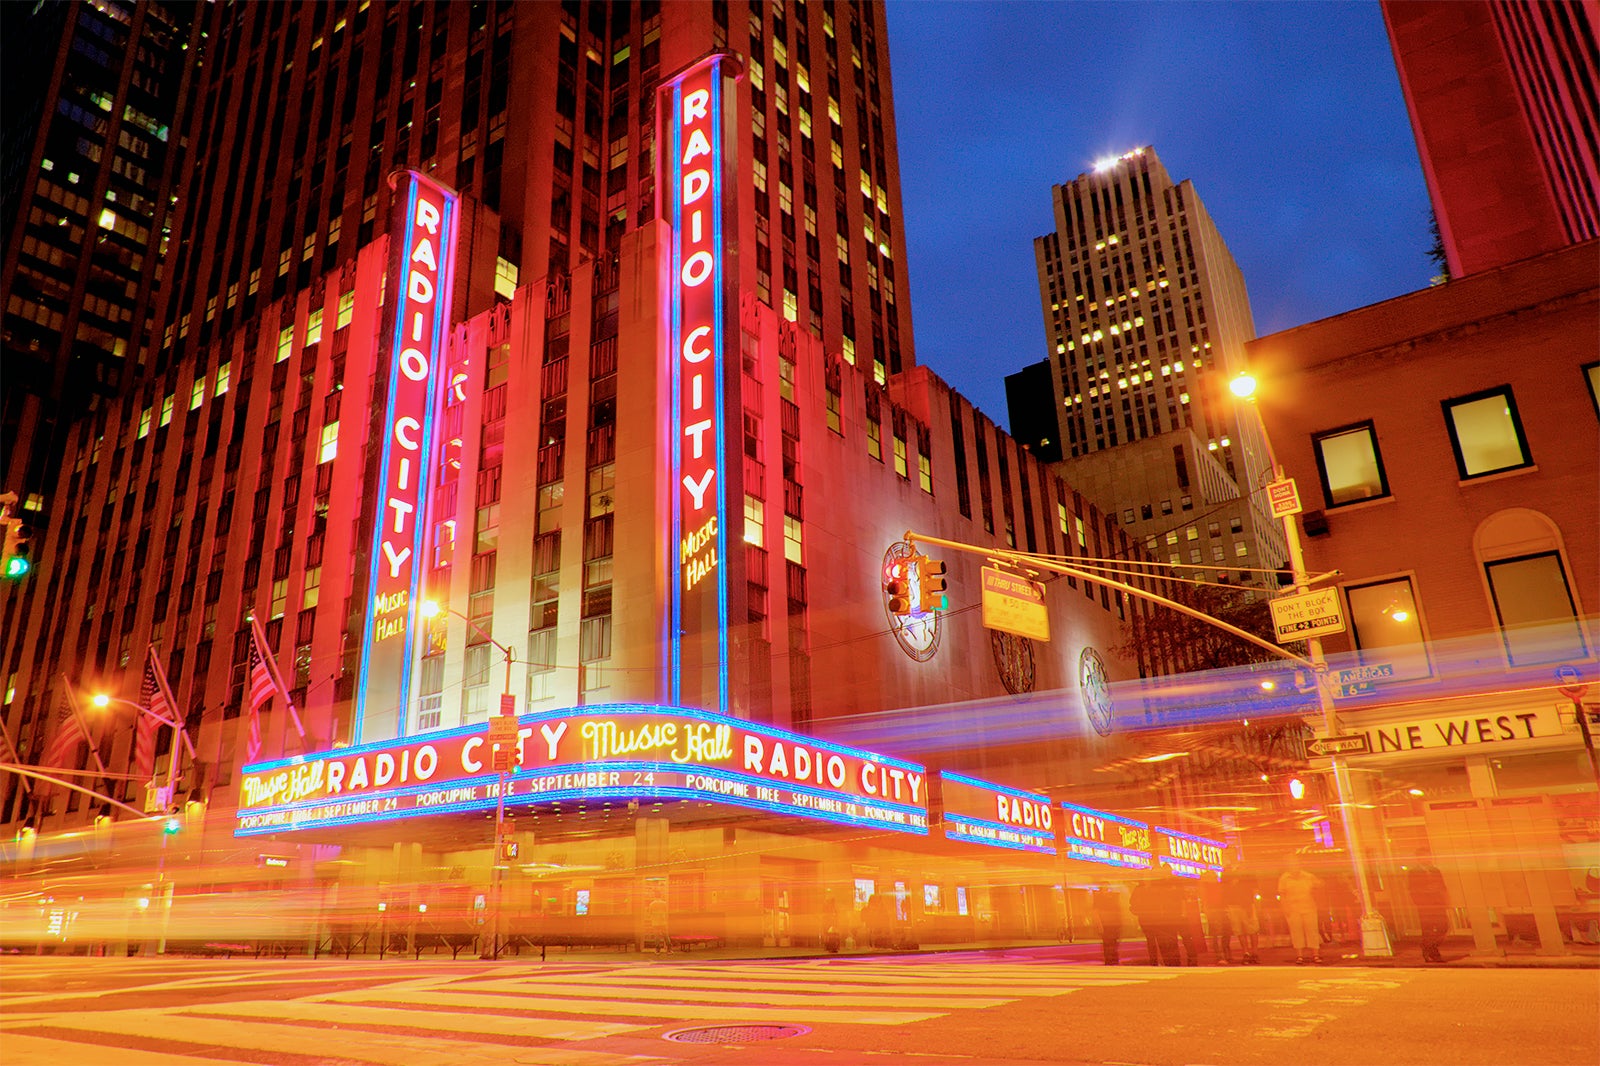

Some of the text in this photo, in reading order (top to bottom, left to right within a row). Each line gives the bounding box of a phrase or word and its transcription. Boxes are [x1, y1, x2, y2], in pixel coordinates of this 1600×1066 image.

[681, 88, 715, 510] RADIO CITY
[382, 198, 440, 578] RADIO CITY
[680, 516, 719, 565] MUSIC
[686, 548, 719, 591] HALL
[994, 577, 1033, 597] THRU STREET
[1305, 595, 1333, 608] BLOCK
[374, 590, 408, 618] MUSIC
[1287, 606, 1326, 620] THE BOX
[375, 616, 406, 643] HALL
[1281, 625, 1298, 634] FINE
[1311, 615, 1339, 627] POINTS
[1342, 667, 1391, 683] AMERICAS
[1349, 685, 1358, 696] 6
[1314, 740, 1358, 752] ONE WAY
[1364, 712, 1538, 753] INE WEST
[243, 772, 288, 807] Music
[282, 759, 324, 802] Hall
[326, 745, 438, 794] RADIO
[461, 721, 568, 774] CTY
[581, 720, 678, 760] Music
[670, 722, 734, 764] Hall
[743, 734, 846, 788] RADIO
[861, 763, 922, 803] CITY
[324, 800, 379, 818] SEPTEMBER
[383, 797, 398, 811] 24
[416, 786, 477, 807] PORCUPINE
[531, 771, 620, 793] SEPTEMBER
[633, 771, 655, 786] 24
[686, 774, 750, 798] PORCUPINE
[756, 785, 780, 803] TREE
[791, 791, 842, 813] SEPTEMBER
[845, 801, 857, 815] 24
[864, 805, 906, 824] PORCUPINE
[909, 814, 927, 828] TREE
[996, 794, 1053, 830] RADIO
[955, 822, 967, 835] THE
[1072, 812, 1105, 842] CITY
[1168, 835, 1223, 866] RADIO CITY
